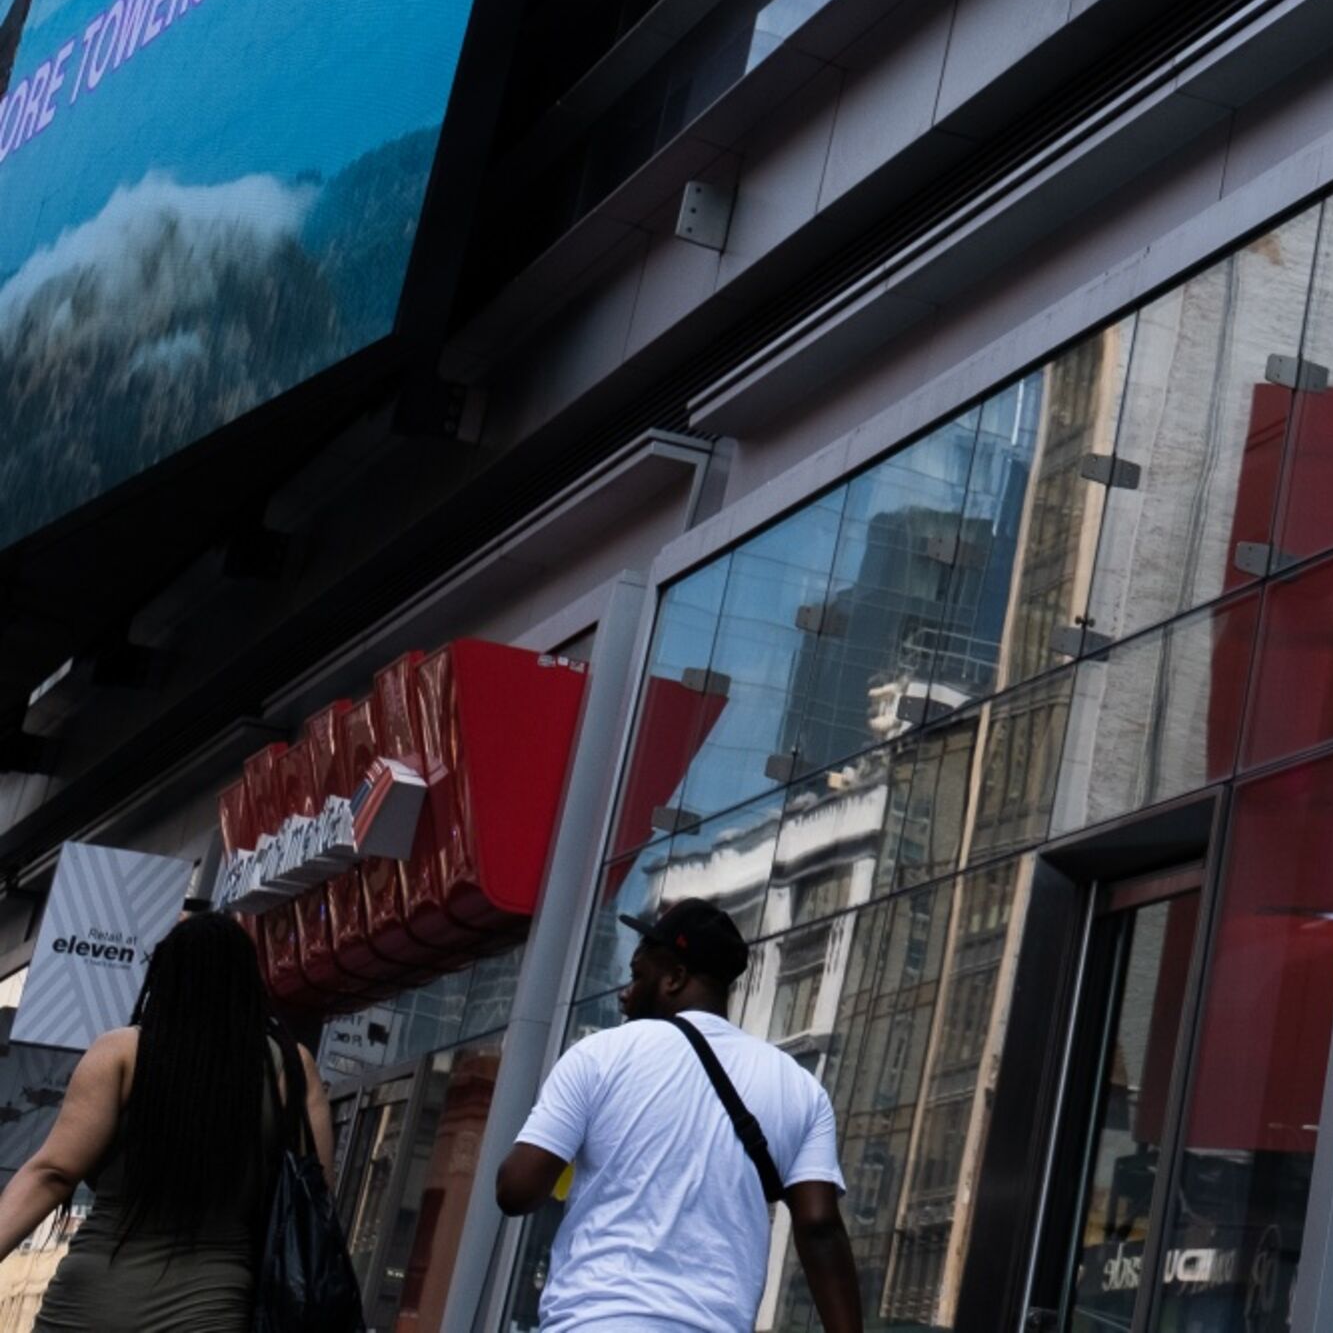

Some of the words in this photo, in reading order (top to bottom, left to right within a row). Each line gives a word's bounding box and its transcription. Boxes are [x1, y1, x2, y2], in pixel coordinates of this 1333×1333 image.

[0, 39, 75, 165] ORE
[52, 935, 134, 963] eleven
[88, 928, 122, 942] Retail
[126, 936, 137, 945] at
